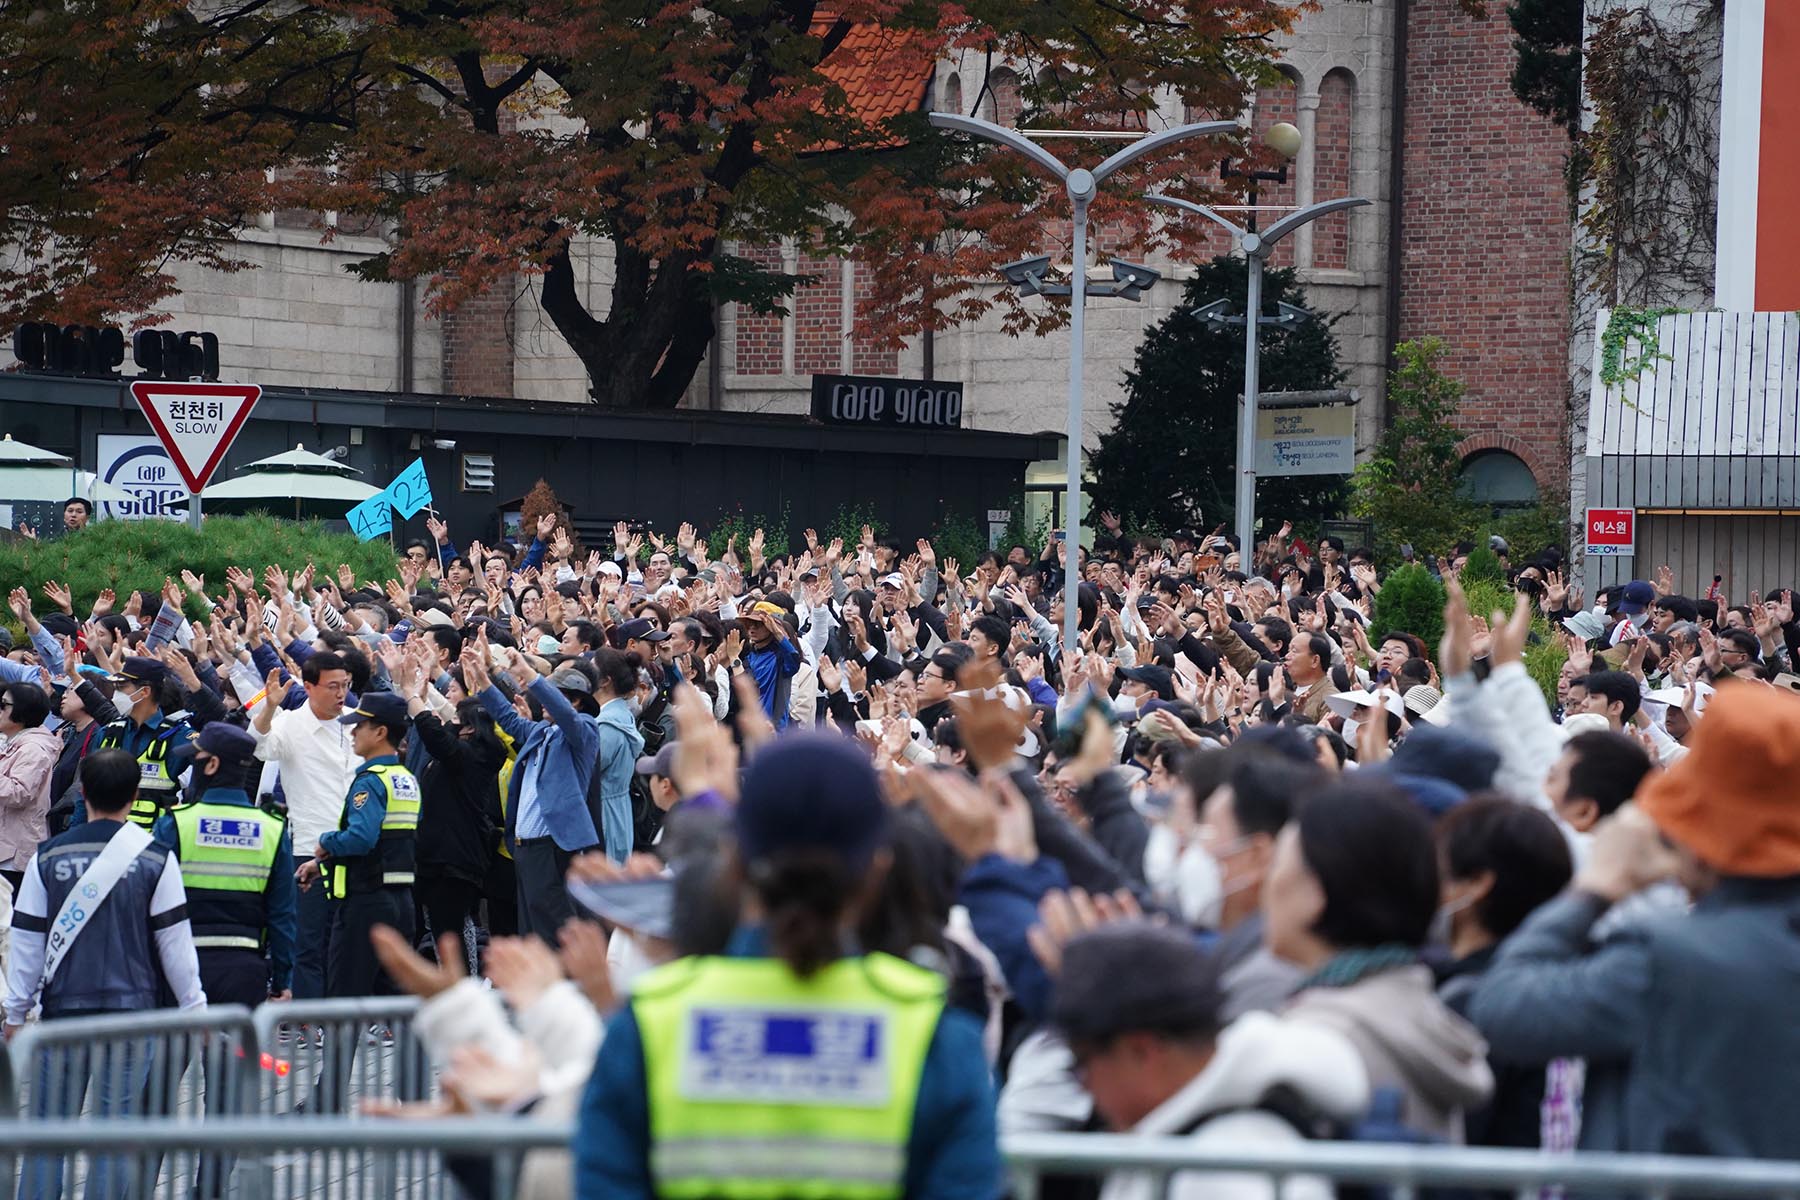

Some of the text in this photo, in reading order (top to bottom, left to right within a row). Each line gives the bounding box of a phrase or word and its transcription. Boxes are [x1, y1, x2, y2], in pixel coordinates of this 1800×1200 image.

[169, 401, 223, 421] 천천히
[832, 384, 961, 425] cafe grace
[175, 422, 217, 434] SLOW
[138, 466, 165, 482] cafe
[1593, 521, 1626, 534] 에스원
[1588, 545, 1617, 553] SECOM
[205, 820, 255, 837] 경찰
[203, 836, 254, 846] POLICE
[55, 856, 138, 881] STF
